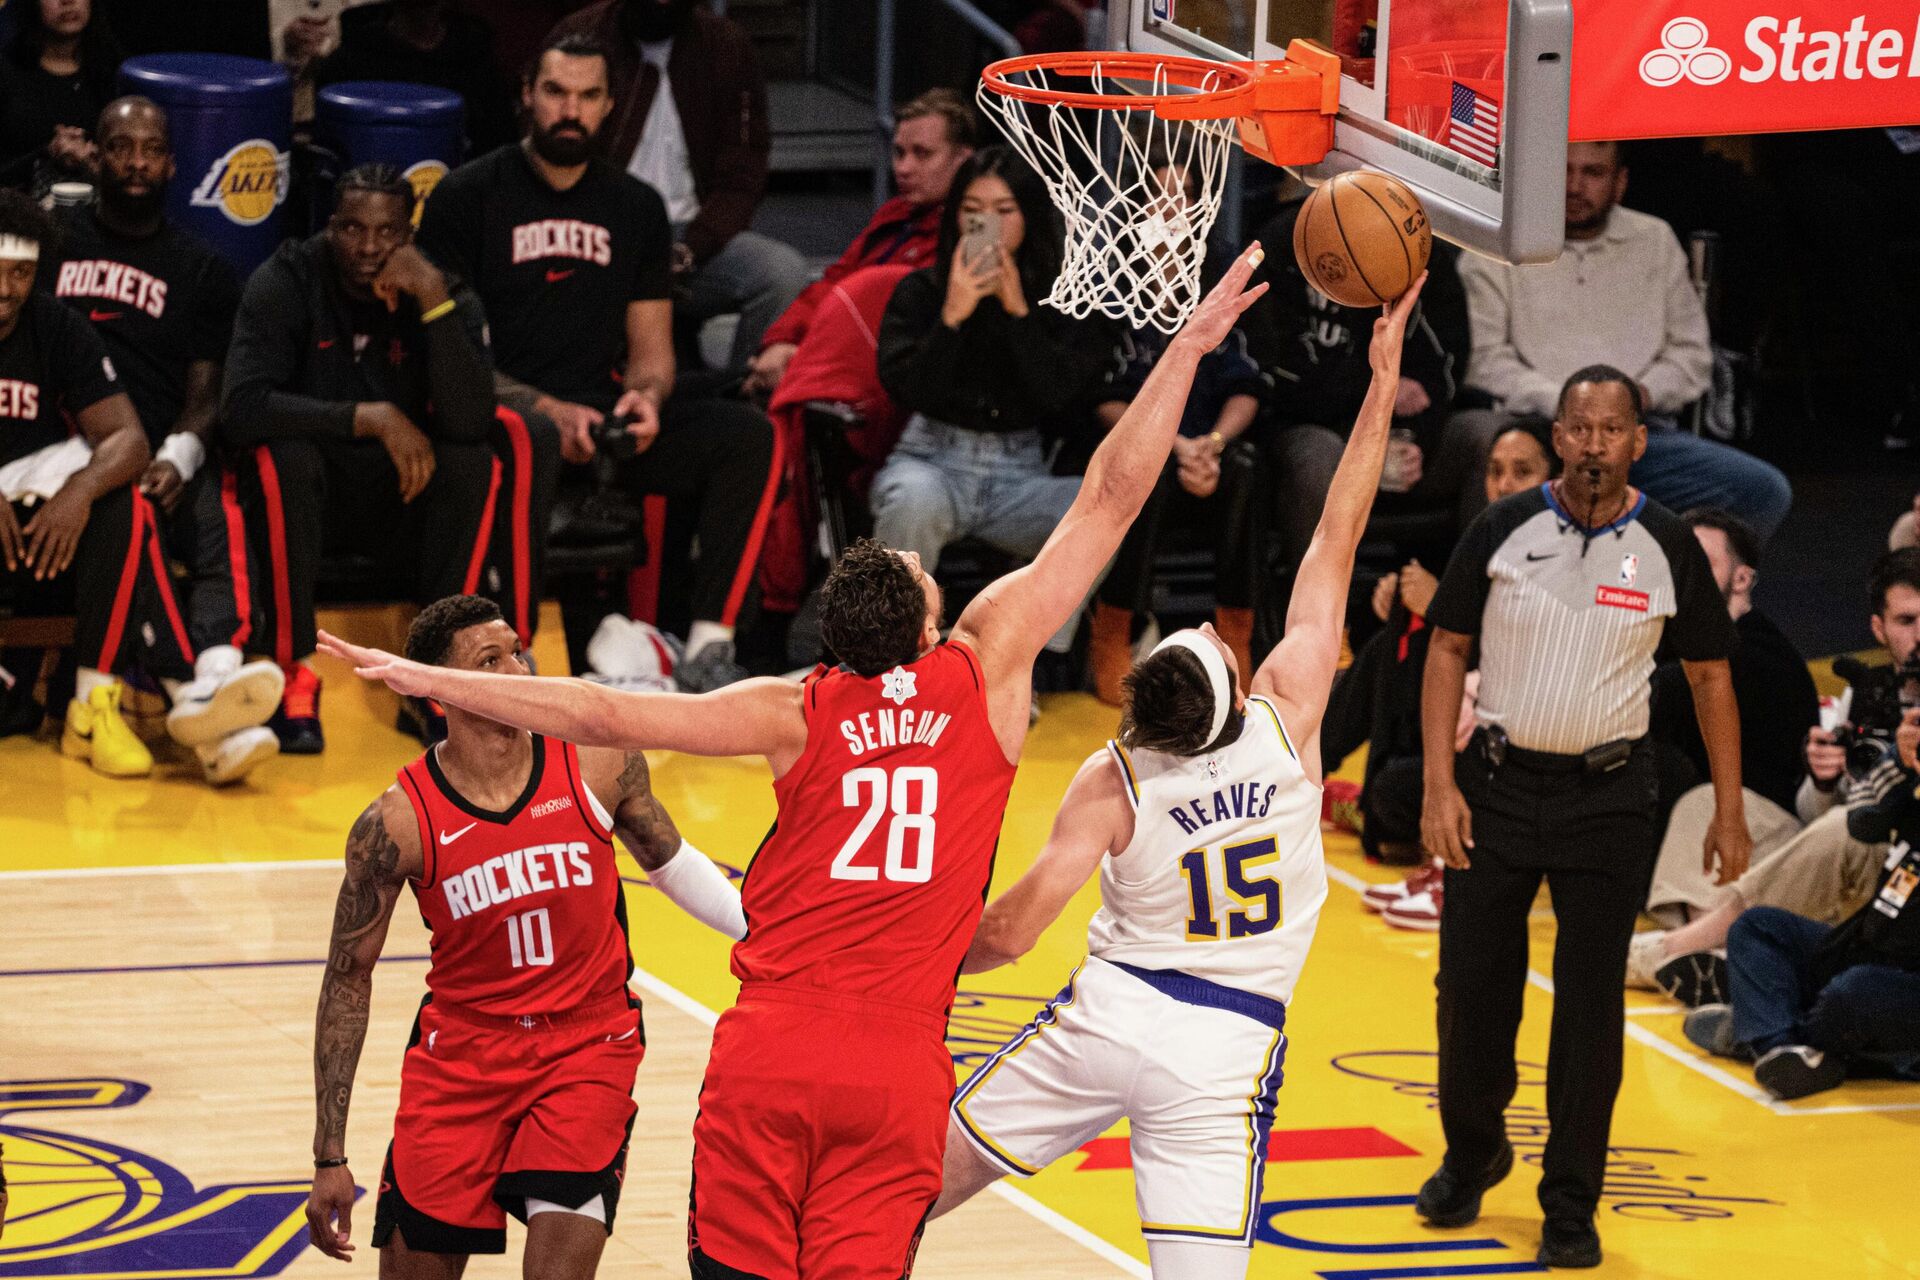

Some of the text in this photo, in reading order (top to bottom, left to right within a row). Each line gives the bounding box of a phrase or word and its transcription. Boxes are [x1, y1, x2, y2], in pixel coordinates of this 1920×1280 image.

[1740, 15, 1904, 84] State
[513, 219, 611, 265] ROCKETS
[57, 259, 168, 318] ROCKETS
[0, 379, 39, 420] ETS
[1598, 588, 1649, 608] Emirates
[840, 708, 952, 756] SENGUN
[530, 795, 571, 811] MEMORIAL
[531, 801, 572, 819] HERMANN
[829, 766, 940, 884] 28
[1168, 782, 1278, 835] REAVES
[441, 841, 594, 922] ROCKETS
[1178, 834, 1284, 942] 15
[503, 907, 555, 968] 10
